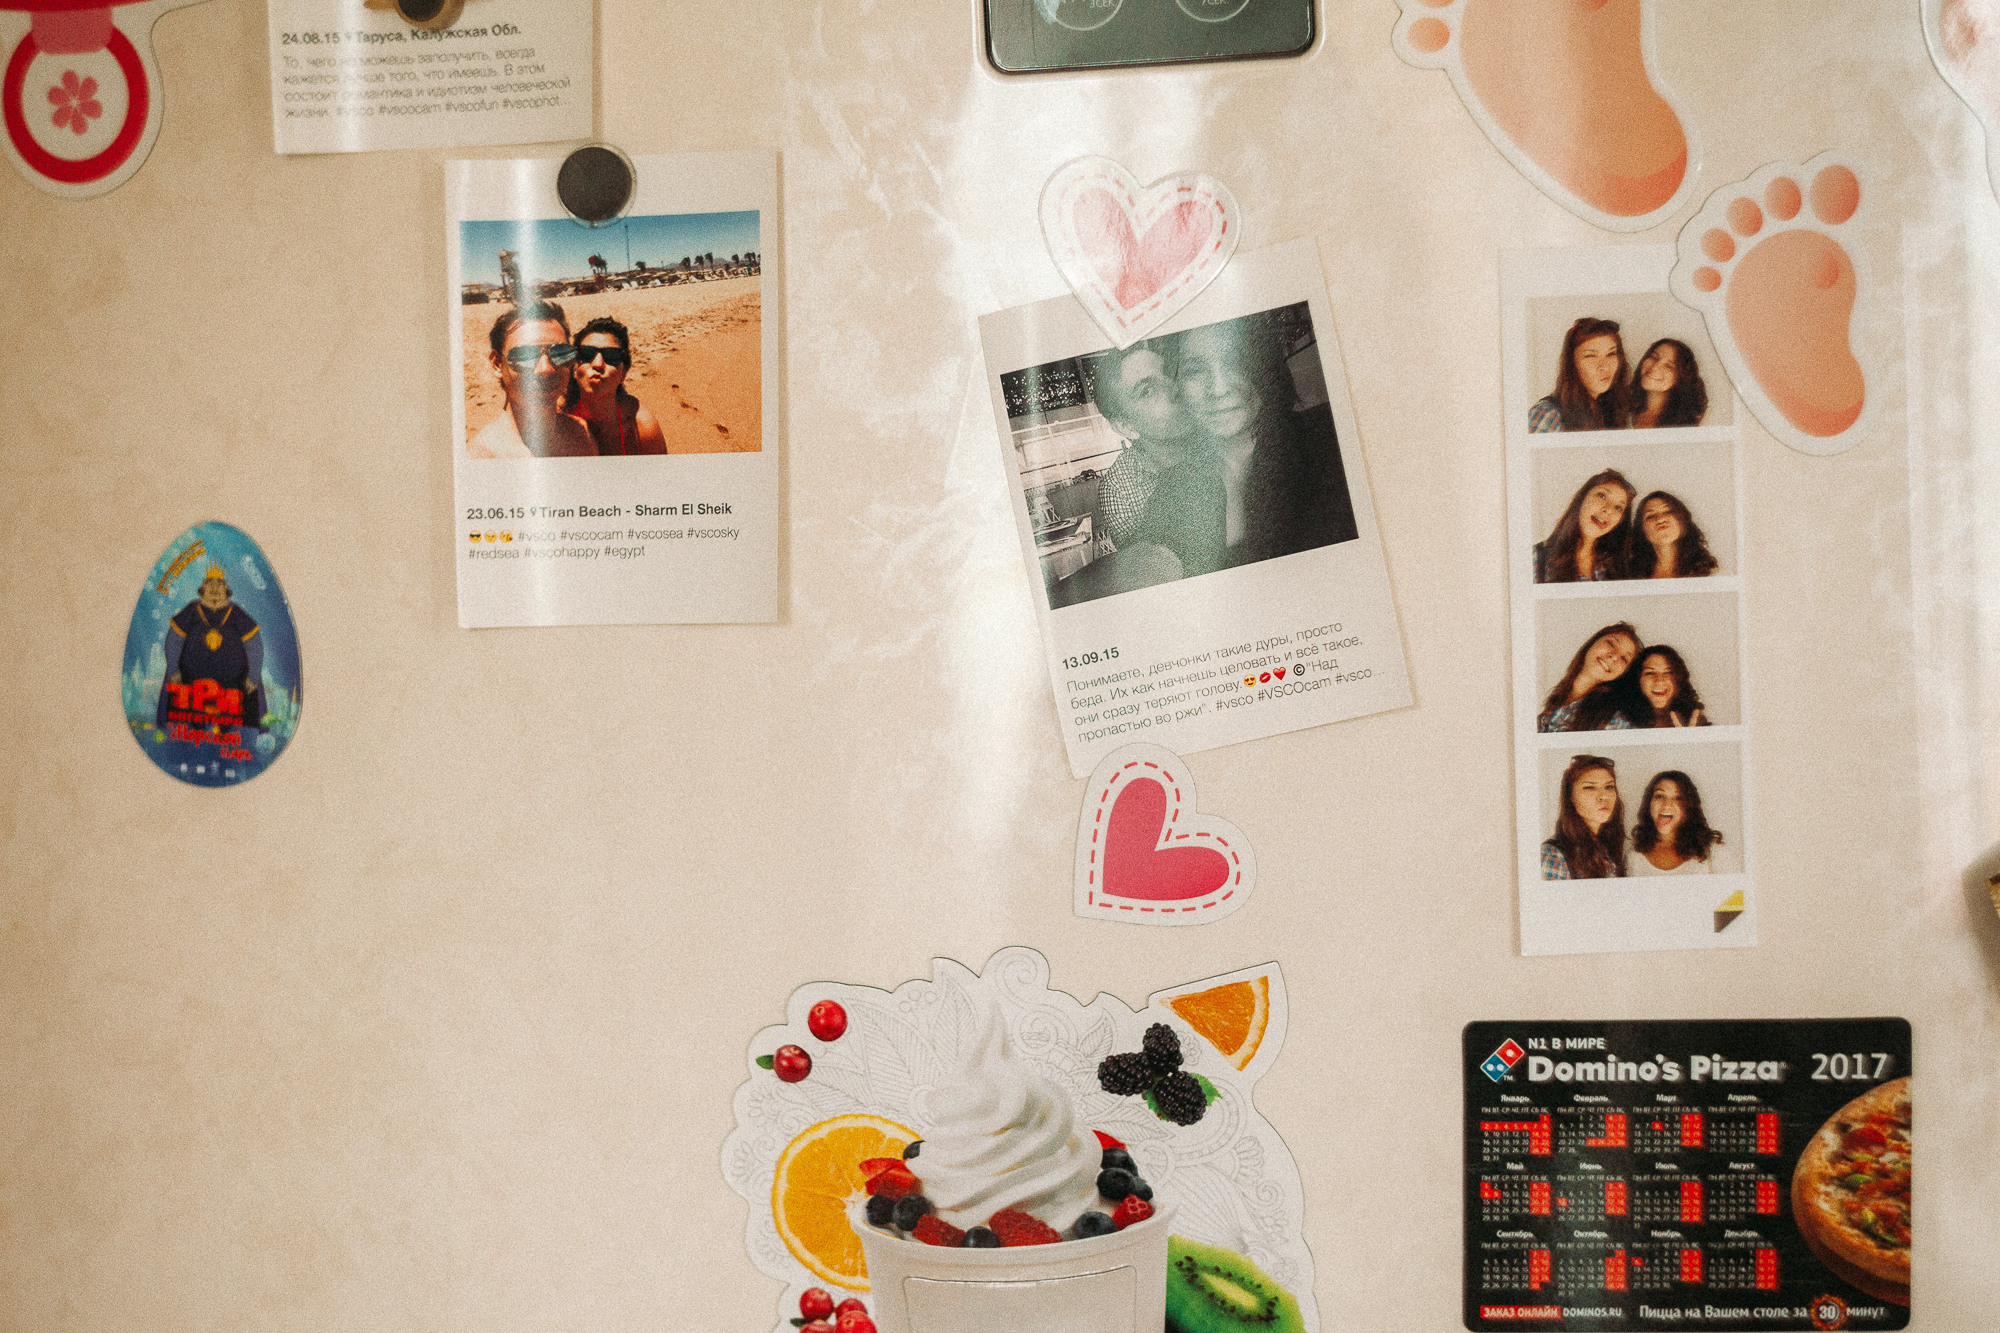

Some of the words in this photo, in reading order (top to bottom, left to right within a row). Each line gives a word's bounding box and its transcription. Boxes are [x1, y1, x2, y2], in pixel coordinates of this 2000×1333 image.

[281, 32, 340, 45] 24.08.15
[356, 30, 408, 45] Таруса,
[411, 27, 488, 42] Калужская
[491, 23, 521, 37] Обл.
[503, 63, 514, 76] В
[516, 64, 546, 75] этом
[416, 87, 425, 97] и
[467, 507, 525, 520] 23.06.15
[540, 506, 575, 518] Tiran
[579, 505, 621, 517] Beach
[635, 504, 678, 516] Sharm
[681, 503, 694, 515] El
[697, 502, 733, 515] Sheik
[518, 531, 556, 542] #vsco
[560, 529, 624, 541] #vscocam
[627, 528, 684, 540] #vscosea
[687, 526, 740, 541] #vscosky
[469, 547, 520, 559] #redsea
[604, 544, 646, 560] #egypt
[1062, 646, 1120, 670] 13.09.15
[1066, 668, 1145, 694] Понимаете,
[1148, 651, 1212, 677] девчонки
[1215, 642, 1252, 659] такие
[1255, 634, 1293, 652] дуры,
[1296, 622, 1343, 642] просто
[1070, 693, 1107, 710] беда.
[1109, 687, 1129, 701] Их
[1132, 681, 1156, 696] как
[1158, 667, 1217, 690] начнешь
[1219, 654, 1281, 677] целовать
[1284, 649, 1293, 662] и
[1296, 643, 1320, 659] всё
[1322, 635, 1363, 653] такое,
[1074, 712, 1099, 726] они
[1102, 702, 1141, 721] сразу
[1145, 690, 1192, 711] теряют
[1195, 680, 1243, 698] голову.
[1078, 717, 1152, 744] пропастью
[1155, 713, 1172, 725] во
[1215, 694, 1254, 712] #vsco
[1257, 676, 1332, 702] #VSCOcam
[1528, 1037, 1547, 1050] N1
[1551, 1037, 1561, 1050] В
[1565, 1037, 1606, 1050] МИРЕ
[1528, 1053, 1681, 1082] Domino's
[1811, 1052, 1889, 1080] 2017
[1500, 1094, 1531, 1104] Январь
[1573, 1093, 1609, 1104] Февраль
[1483, 1306, 1515, 1318] ЗАКАЗ
[1517, 1304, 1560, 1318] ОНЛАЙН
[1562, 1305, 1623, 1318] DOMINOS.RU
[1640, 1304, 1681, 1321] Пицца
[1685, 1308, 1700, 1318] на
[1704, 1304, 1750, 1319] Вашем
[1753, 1307, 1790, 1319] столе
[1793, 1307, 1809, 1318] за
[1818, 1304, 1837, 1320] 30
[1846, 1305, 1886, 1320] минут
